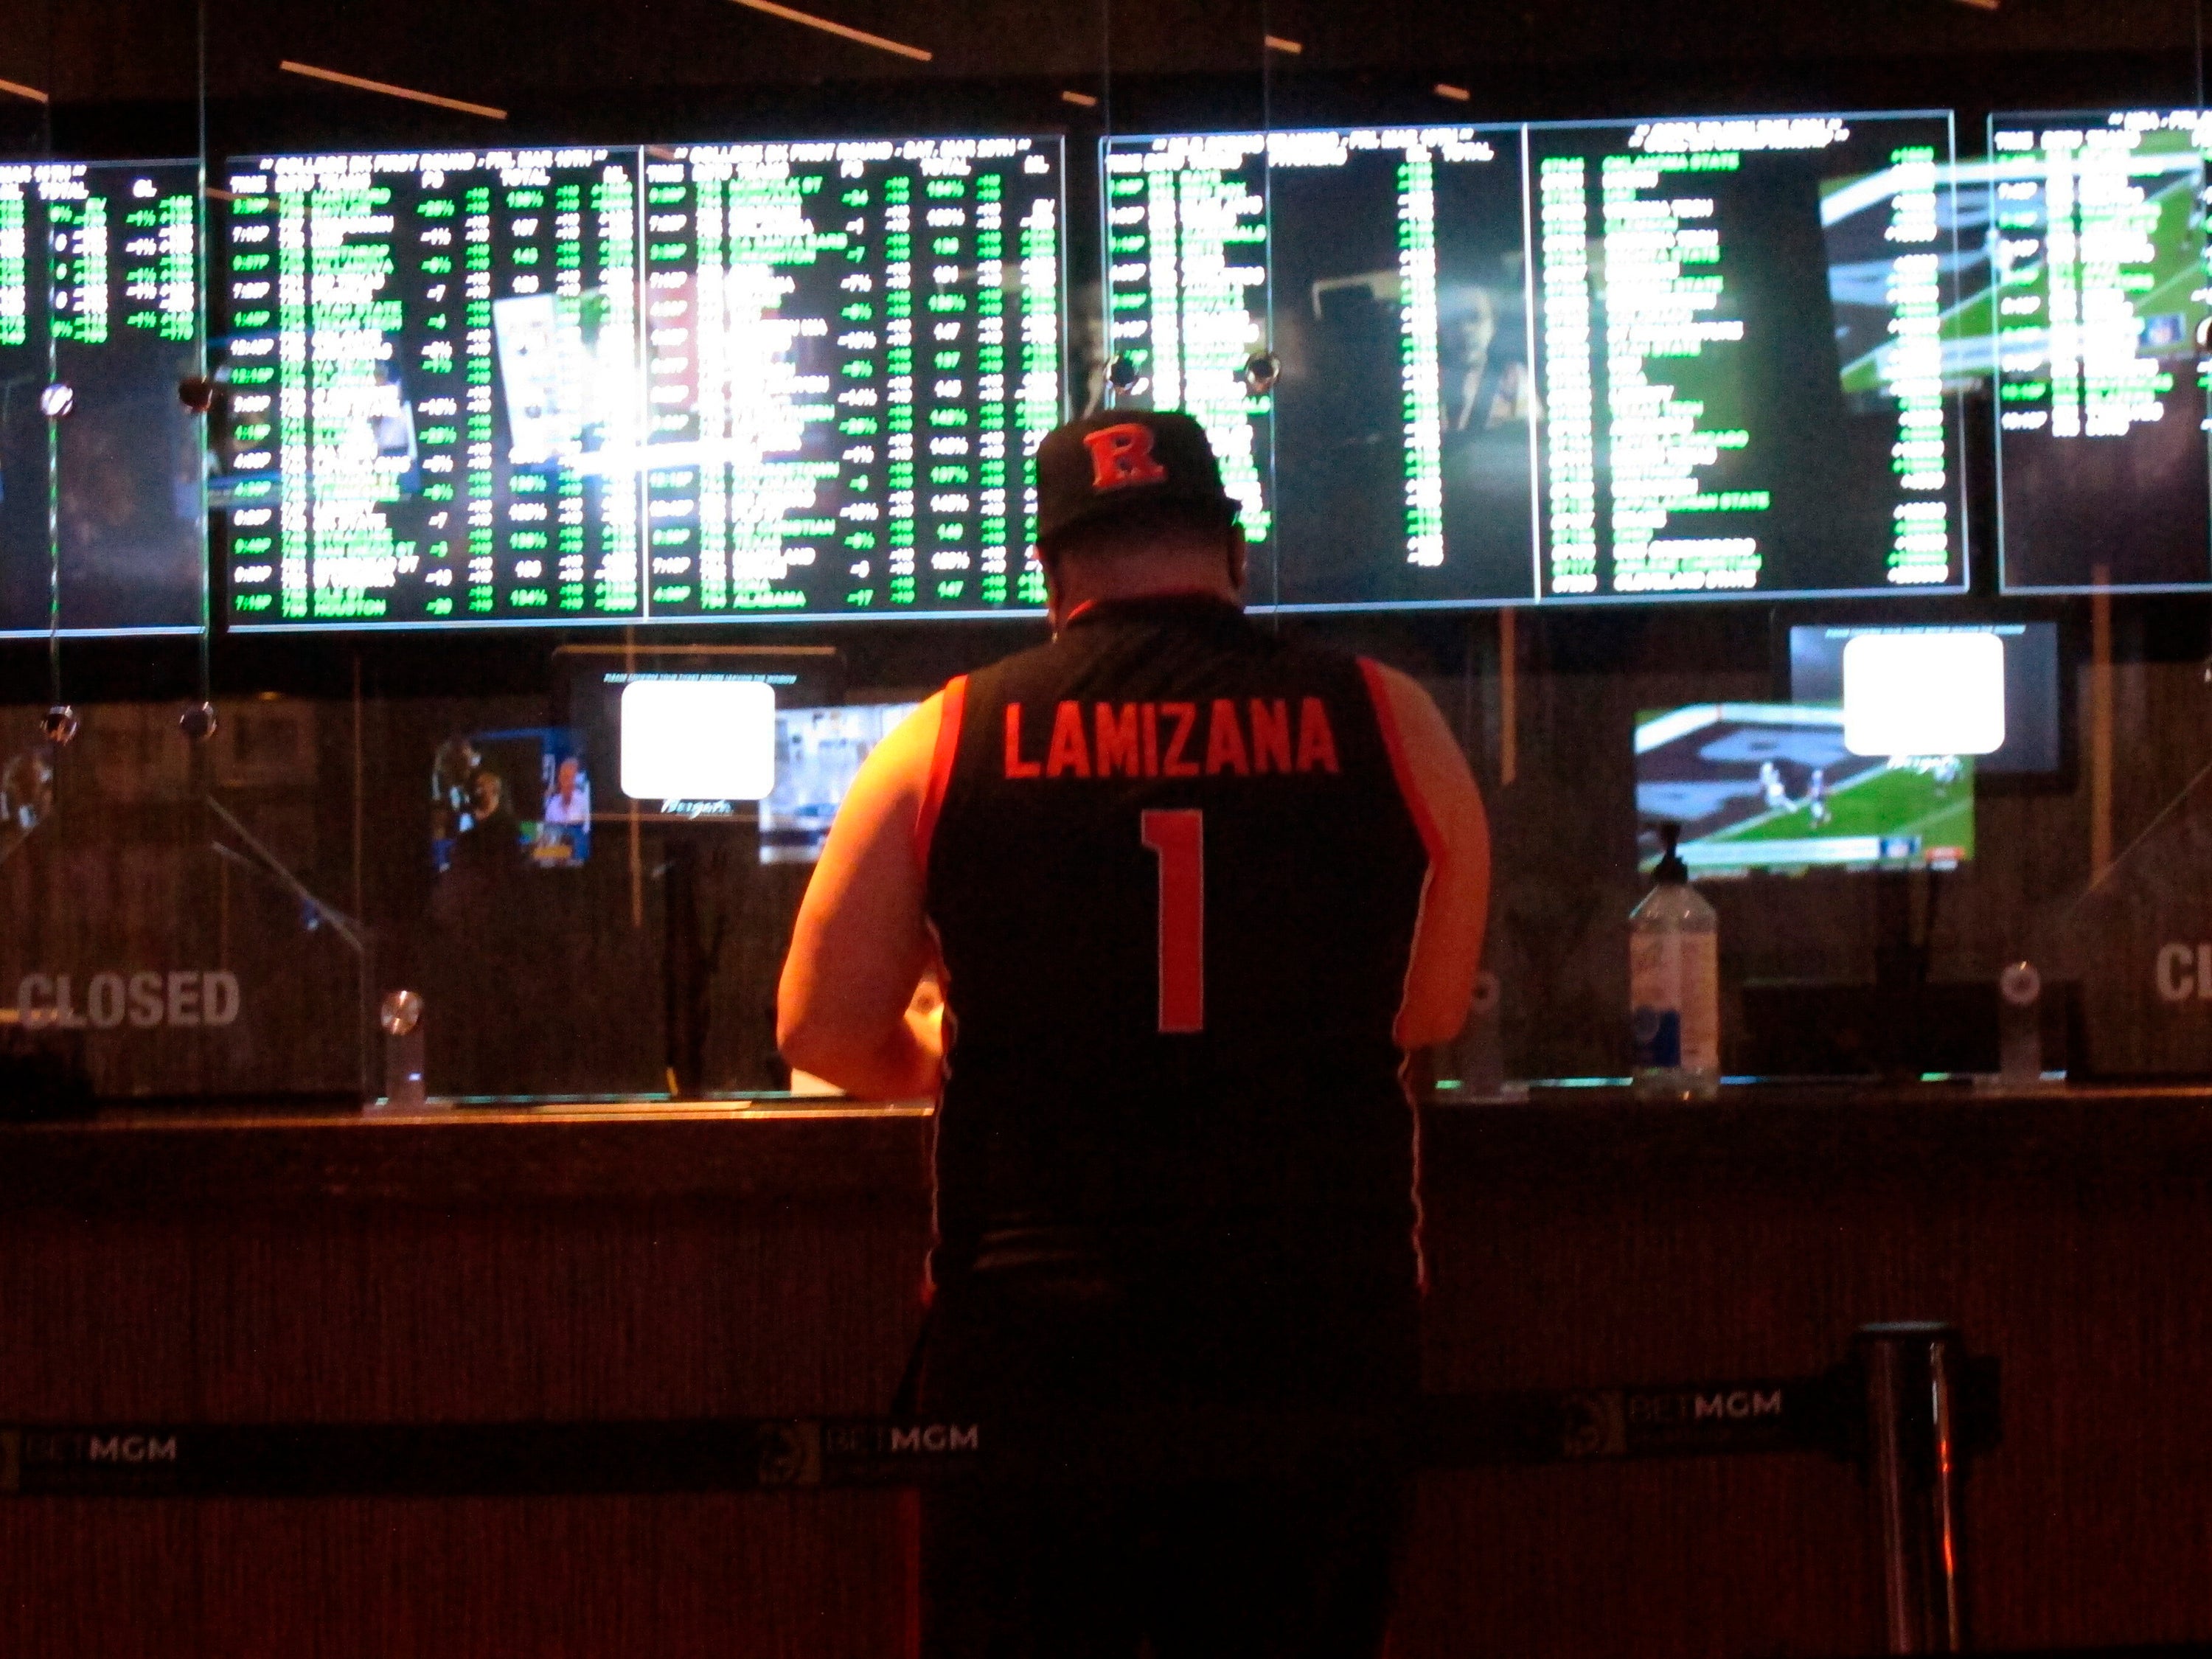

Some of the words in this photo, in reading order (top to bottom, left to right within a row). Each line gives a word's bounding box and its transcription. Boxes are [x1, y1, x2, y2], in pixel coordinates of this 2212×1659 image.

[1083, 422, 1166, 490] R
[1004, 697, 1340, 779] LAMIZANA
[1141, 809, 1204, 1032] 1
[17, 970, 240, 1029] CLOSED
